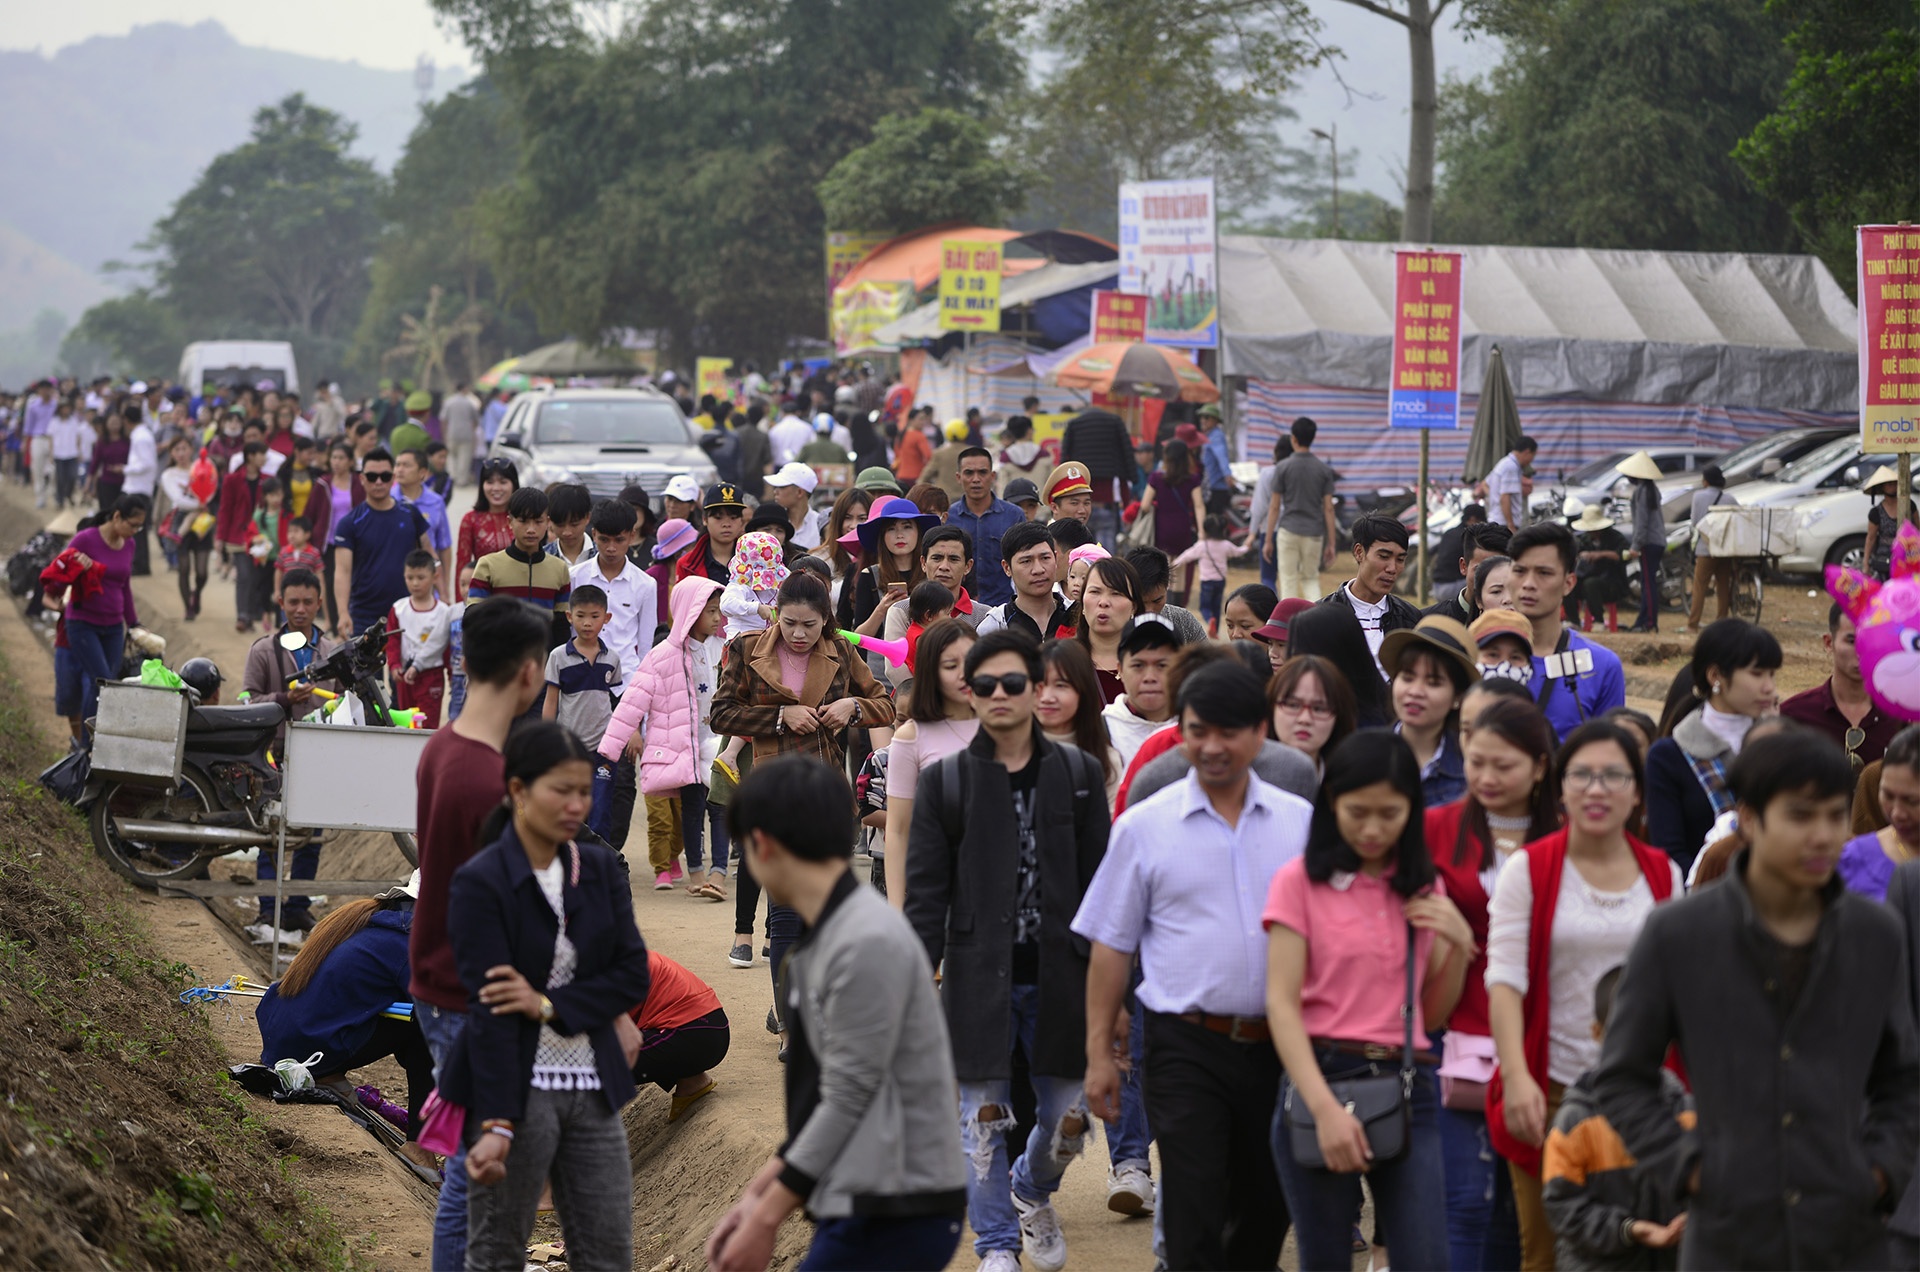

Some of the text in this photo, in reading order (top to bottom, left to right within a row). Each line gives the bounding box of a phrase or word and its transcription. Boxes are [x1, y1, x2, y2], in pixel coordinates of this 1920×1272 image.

[1883, 231, 1904, 250] PHÁT
[1403, 300, 1453, 319] PHÁT HUY
[1885, 306, 1906, 325] SÁNG
[1889, 330, 1906, 350] XÂY
[1882, 355, 1897, 376] QUÊ
